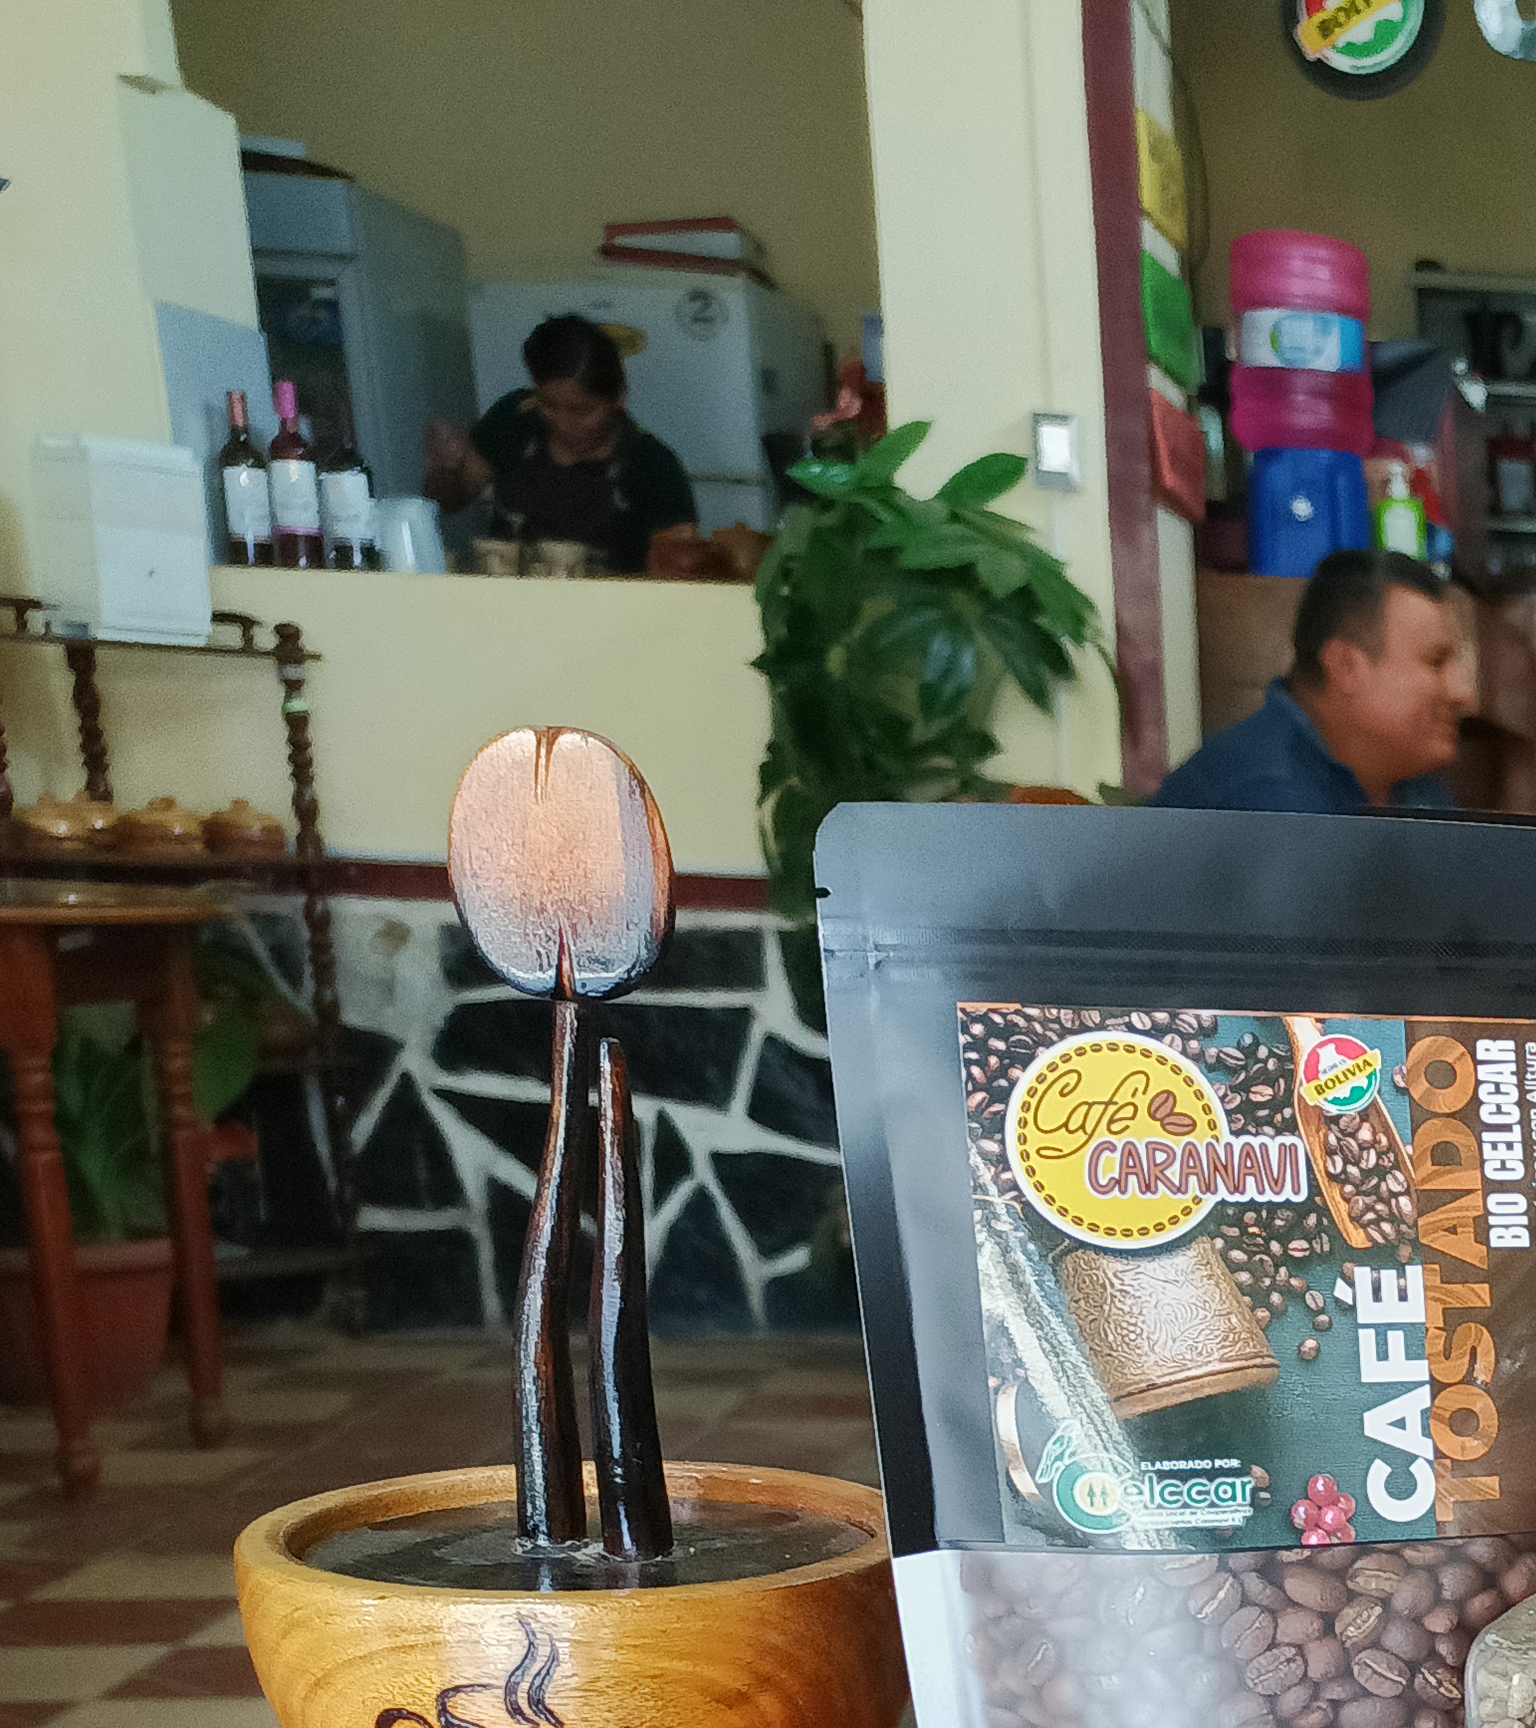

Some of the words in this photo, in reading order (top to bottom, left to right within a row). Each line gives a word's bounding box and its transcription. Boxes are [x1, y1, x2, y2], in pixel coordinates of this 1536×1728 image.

[1314, 1058, 1374, 1096] BOLIVIA
[1475, 1038, 1526, 1181] CELCCAR
[1034, 1069, 1151, 1160] Café
[1088, 1140, 1301, 1196] CARANAVI
[1486, 1192, 1531, 1249] BIO
[1406, 1035, 1501, 1522] TOSTADO
[1333, 1264, 1437, 1523] CAFÉ
[1140, 1459, 1213, 1471] ELABORADO
[1214, 1458, 1242, 1469] POR:
